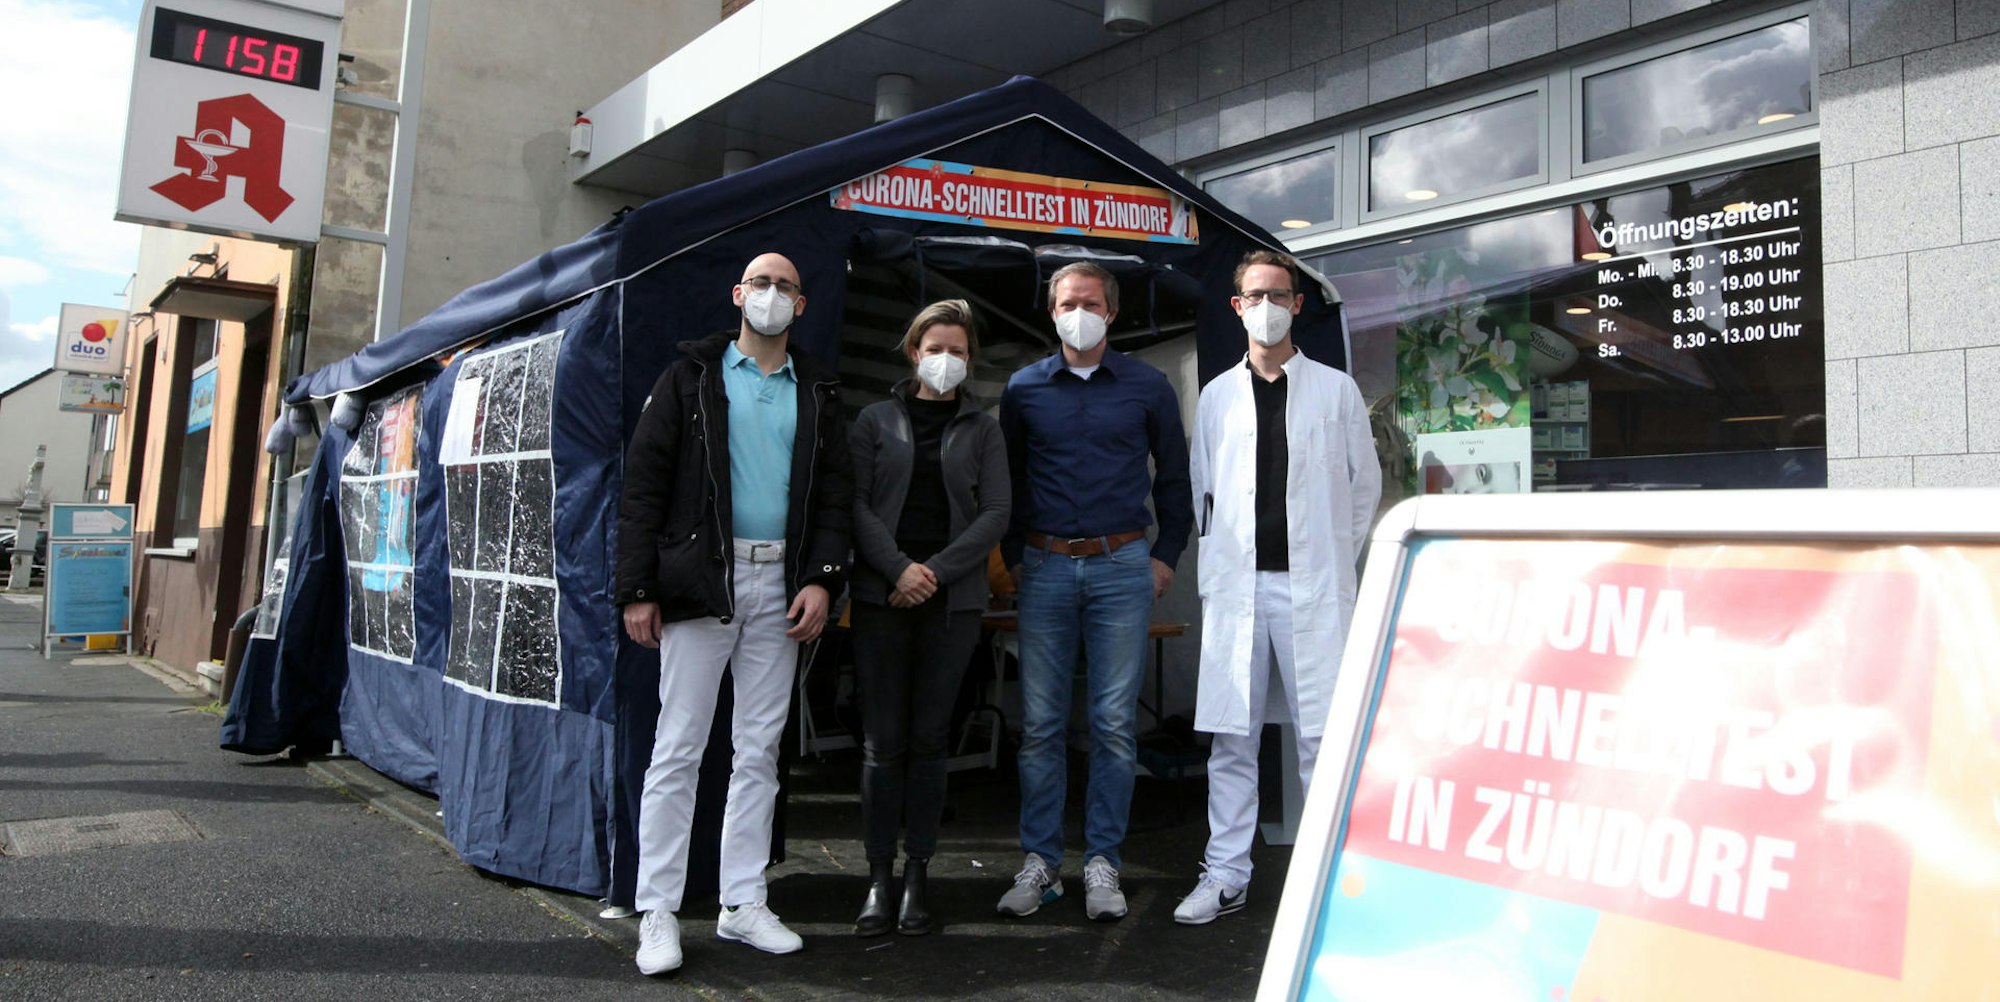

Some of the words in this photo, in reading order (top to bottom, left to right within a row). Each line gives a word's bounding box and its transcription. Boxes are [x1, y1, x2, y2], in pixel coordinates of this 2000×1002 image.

[848, 174, 1066, 225] CORONA-SCHNELLTEST
[1070, 198, 1089, 225] IN
[1094, 195, 1169, 233] ZÜNDORF
[1599, 198, 1799, 249] Öffnungszeiten:
[1598, 269, 1624, 284] Mo.
[1637, 263, 1659, 279] Mi.
[1672, 255, 1705, 273] 8.30
[1720, 246, 1763, 266] 18.30
[1768, 241, 1800, 259] Uhr
[1598, 294, 1623, 309] Do.
[1672, 280, 1705, 298] 8.30
[1720, 273, 1764, 292] 19.00
[1768, 268, 1801, 285] Uhr
[1598, 318, 1617, 333] Fr.
[1672, 306, 1705, 324] 8.30
[1720, 299, 1764, 317] 18.30
[1769, 295, 1802, 312] Uhr
[71, 340, 105, 355] duo
[1598, 343, 1622, 358] Sa.
[1673, 332, 1706, 350] 8.30
[1721, 325, 1765, 344] 13.00
[1769, 323, 1802, 339] Uhr
[1387, 774, 1458, 852] IN
[1464, 780, 1798, 921] ZÜNDORF
